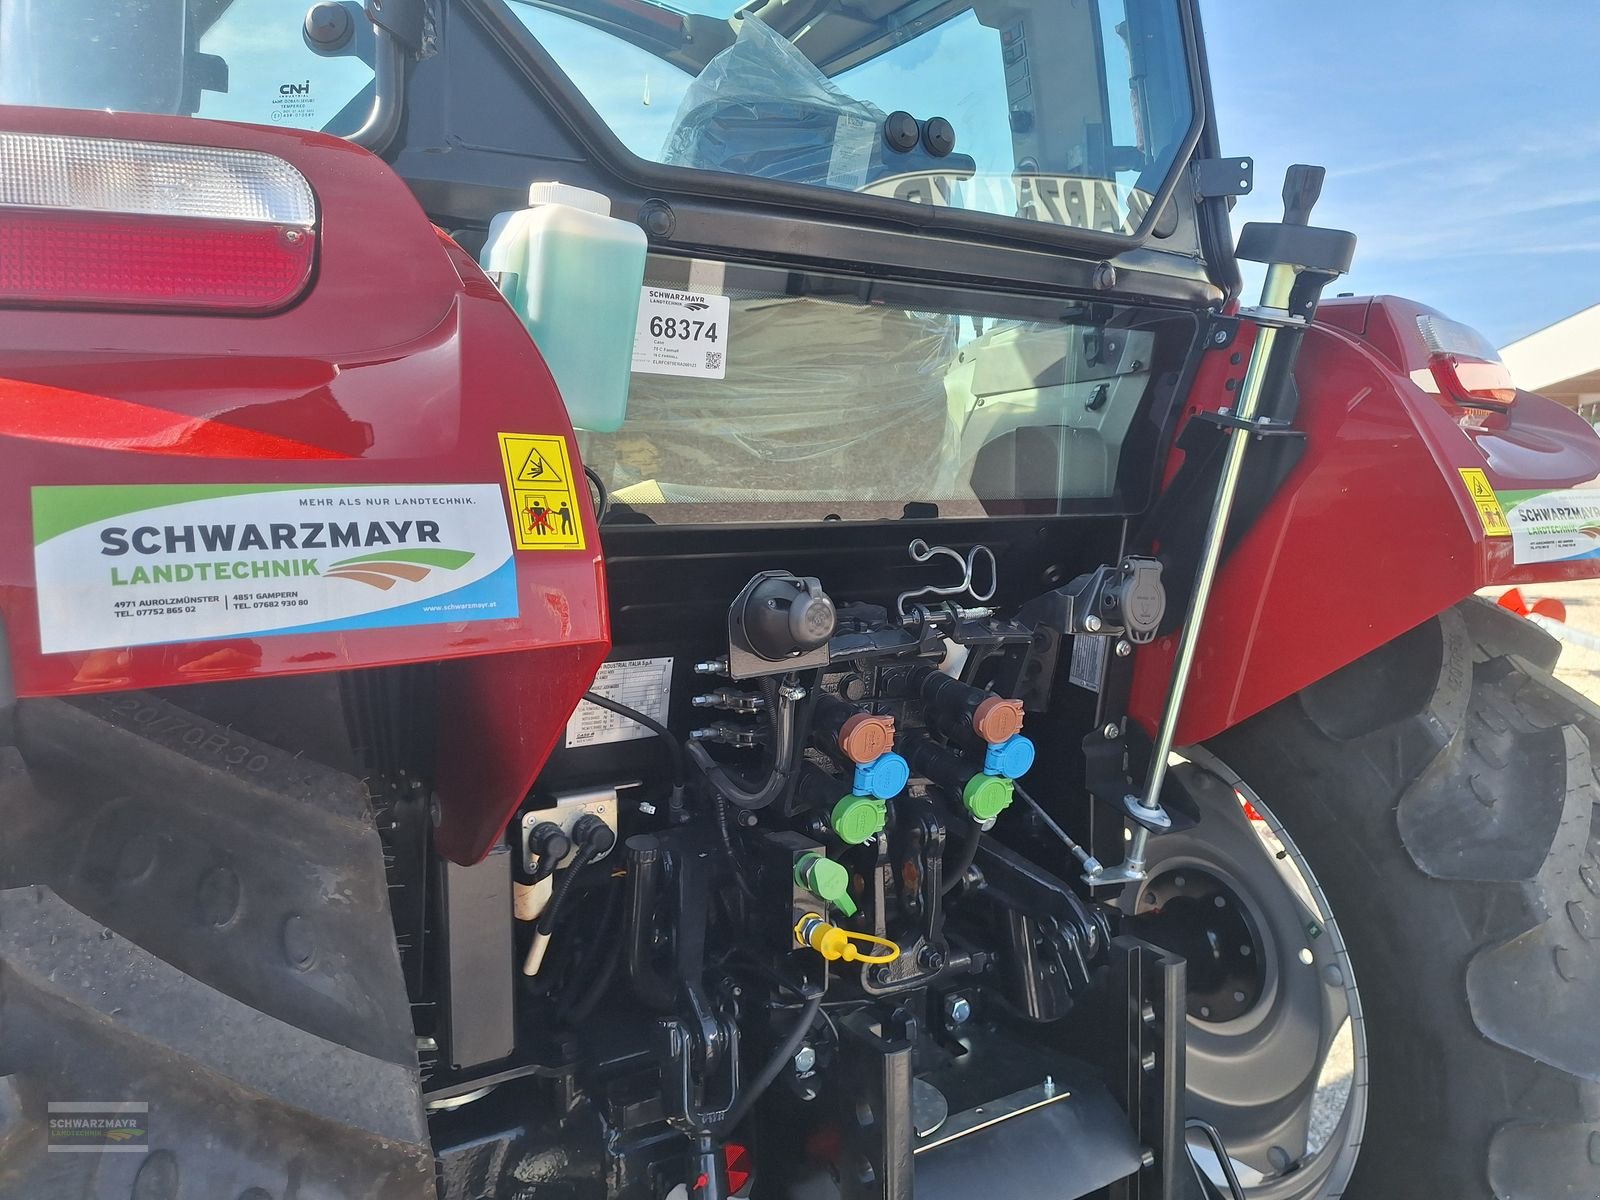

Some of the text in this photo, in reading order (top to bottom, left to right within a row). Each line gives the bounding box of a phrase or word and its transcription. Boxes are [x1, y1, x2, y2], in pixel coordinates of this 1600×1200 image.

[649, 290, 705, 303] SCHWARZMAYR
[650, 316, 718, 343] 68374
[299, 498, 334, 506] MEHR
[100, 520, 441, 556] SCHWARZMAYR
[111, 558, 320, 586] LANDTECHNIK
[139, 596, 220, 606] AUROLZMÜNSTER
[256, 591, 298, 600] GAMPERN
[253, 601, 280, 609] 07682
[422, 601, 496, 613] www.schwarzmayr.at
[136, 608, 164, 617] 07752
